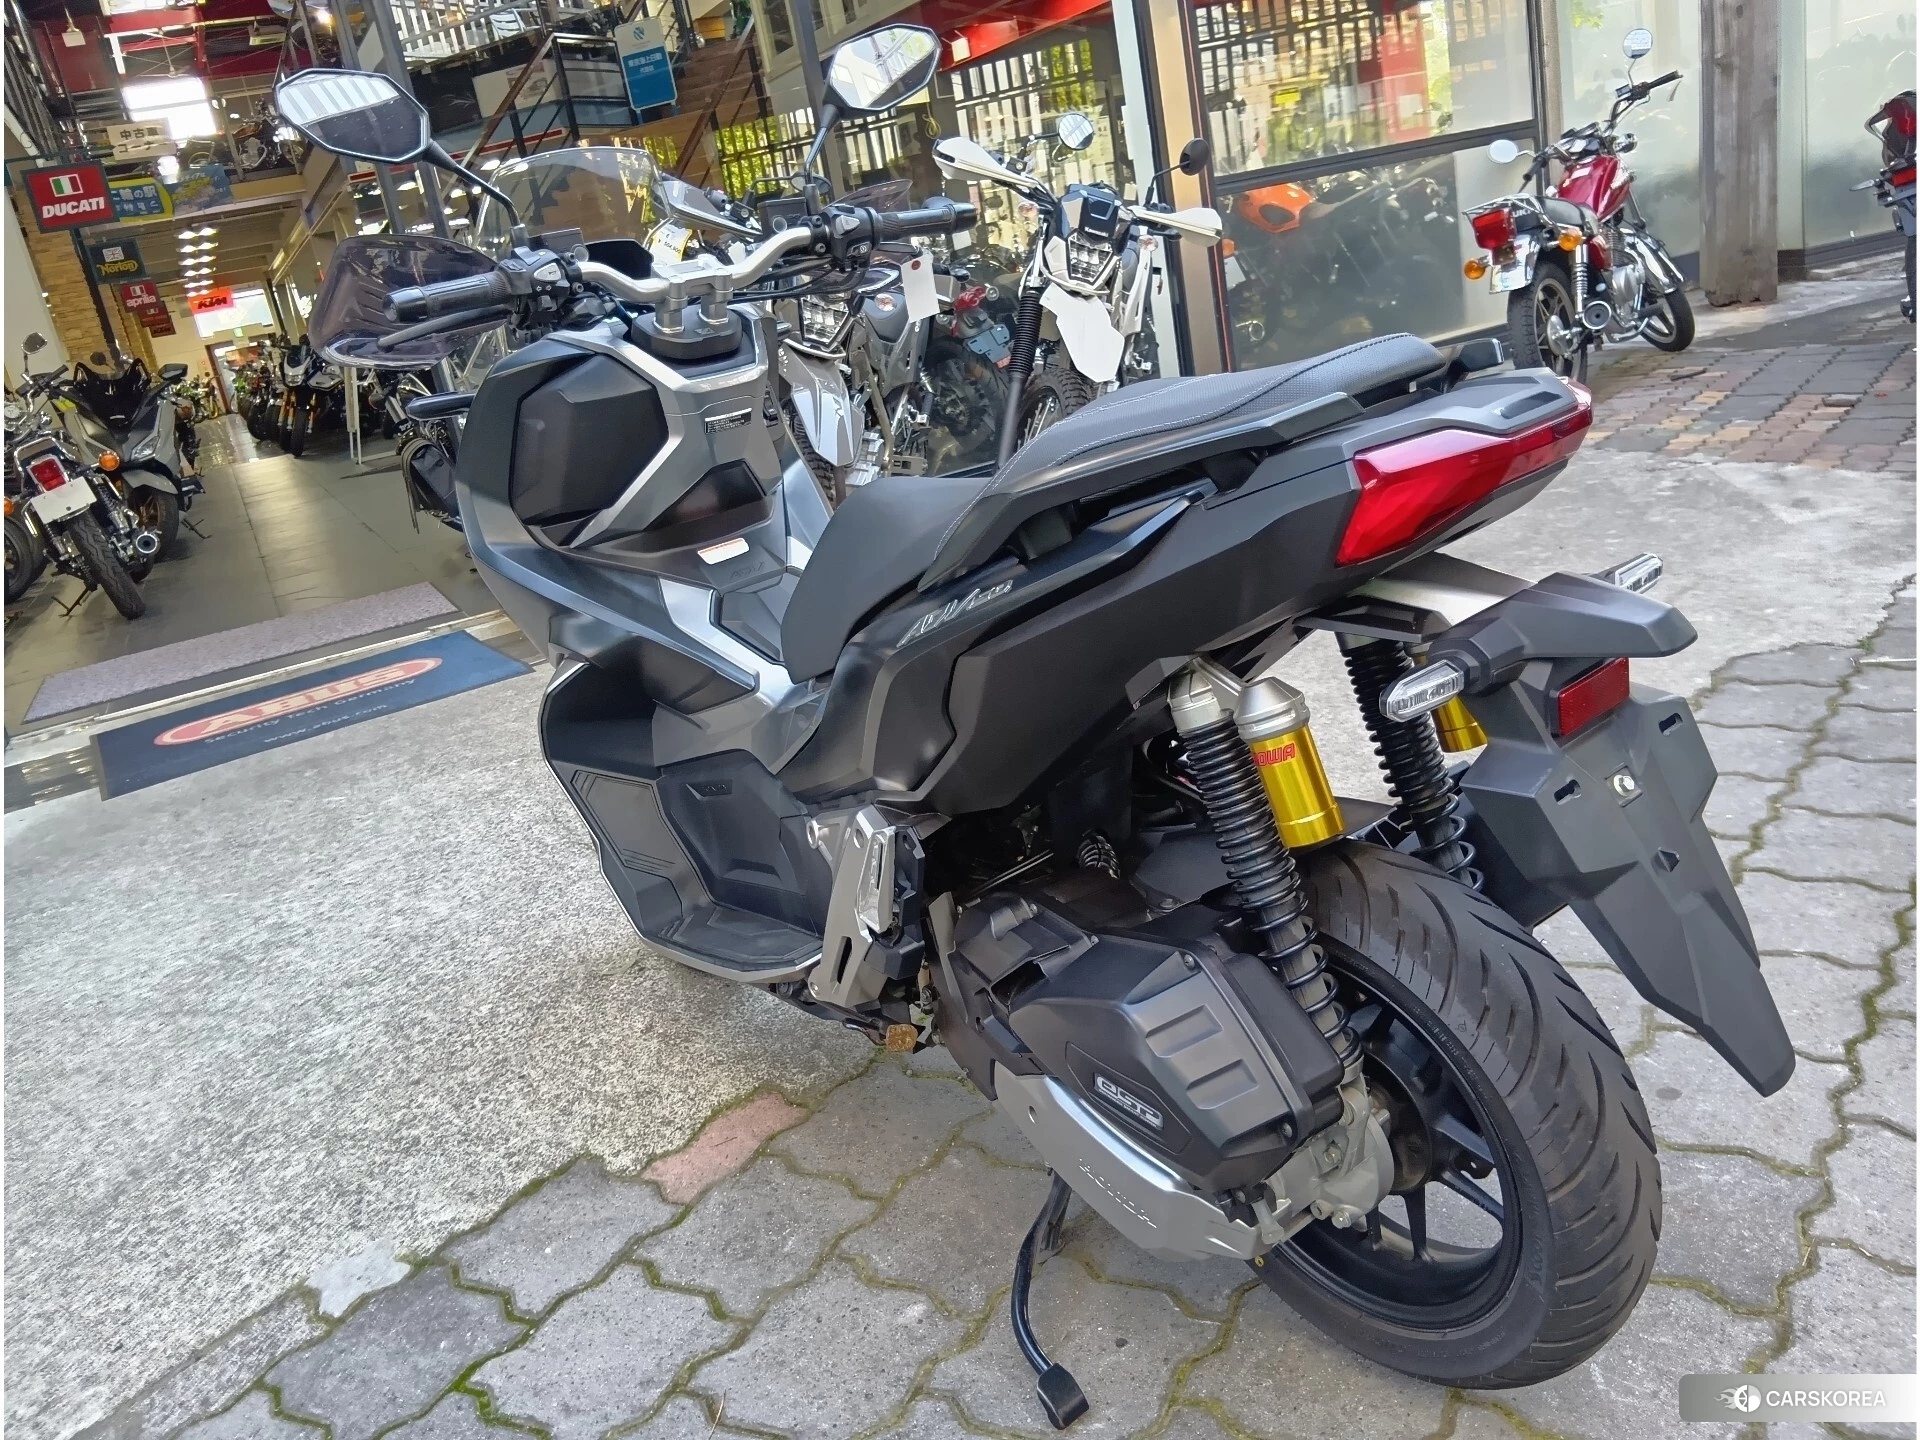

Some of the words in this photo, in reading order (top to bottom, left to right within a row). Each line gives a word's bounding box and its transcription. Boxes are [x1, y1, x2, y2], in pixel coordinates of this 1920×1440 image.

[42, 196, 105, 219] DUCATI
[96, 259, 139, 276] Norton
[126, 293, 157, 308] aprilia
[197, 296, 227, 309] KTM
[200, 667, 406, 734] ABUS
[203, 719, 280, 744] Security
[287, 704, 328, 720] Tech
[334, 678, 416, 706] Germany
[263, 703, 388, 743] www.abus.com
